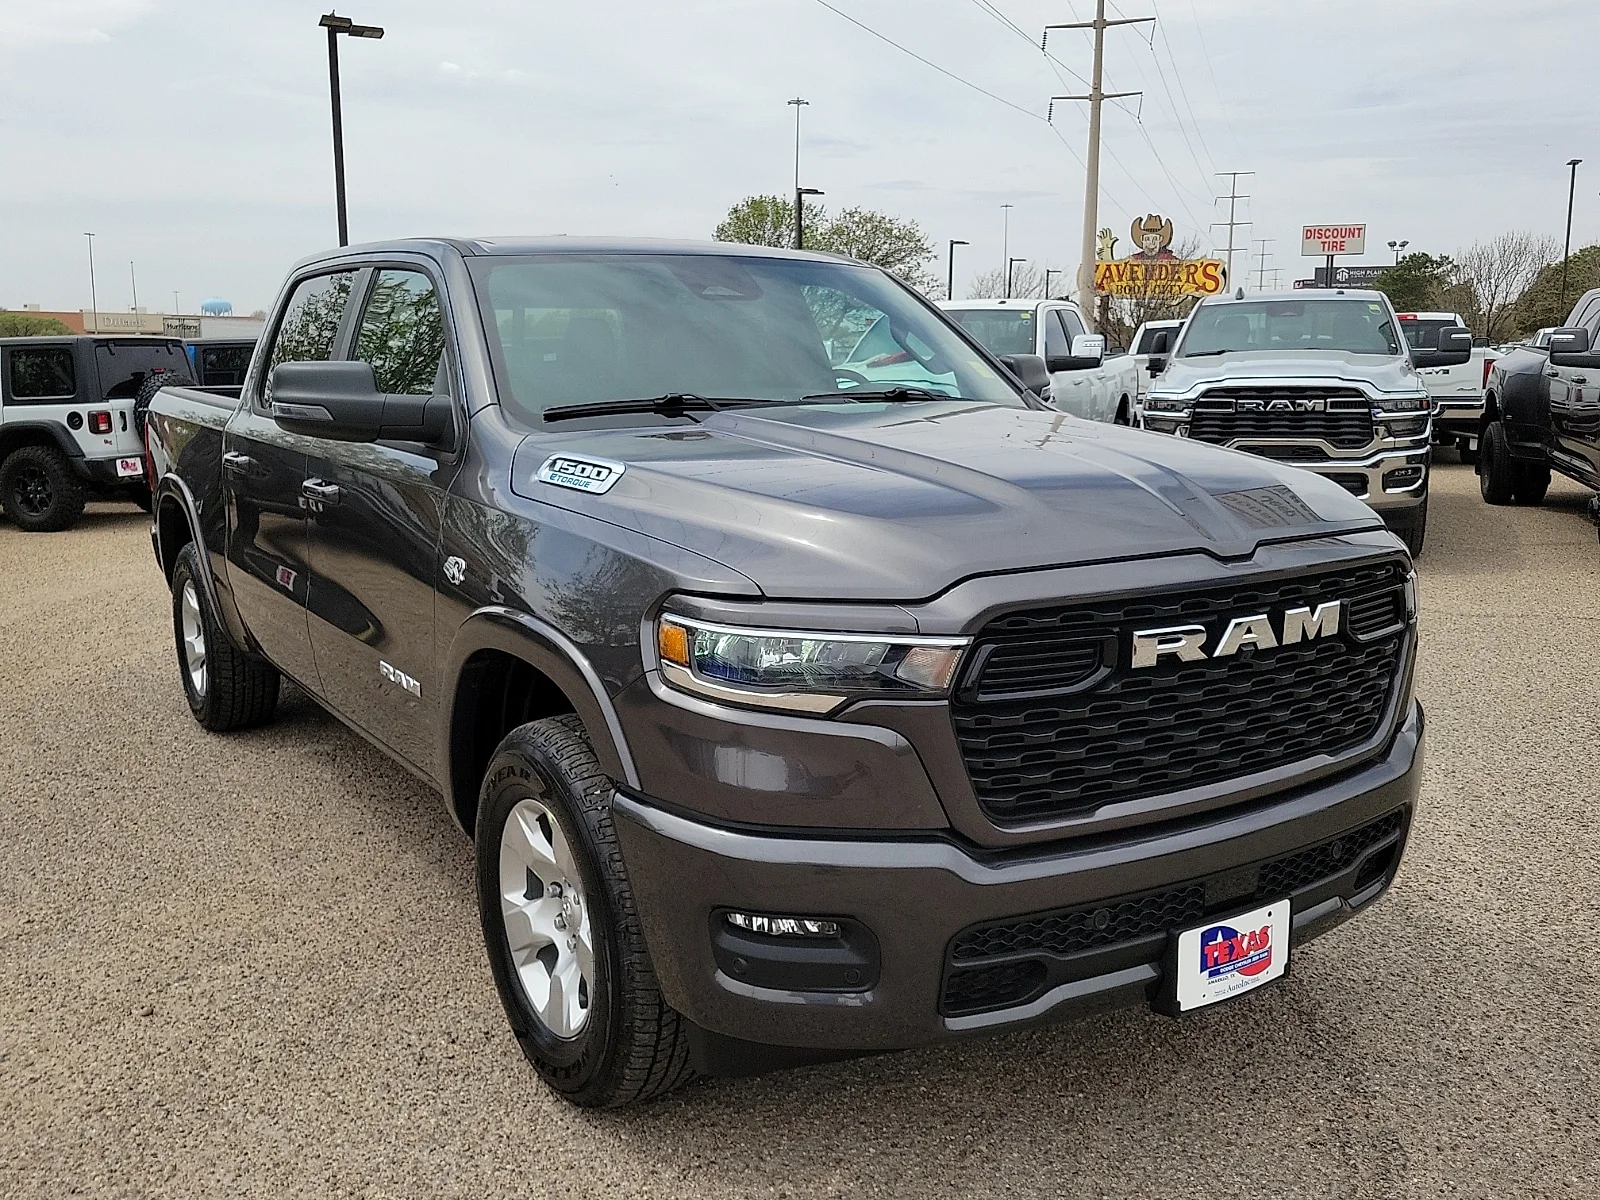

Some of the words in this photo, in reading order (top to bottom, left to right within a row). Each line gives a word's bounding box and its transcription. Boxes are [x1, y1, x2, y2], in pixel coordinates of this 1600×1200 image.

[1305, 227, 1363, 240] DISCOUNT
[1321, 240, 1346, 252] TIRE
[1094, 260, 1221, 294] AVENDER'S
[1237, 399, 1325, 411] RAM
[553, 459, 611, 481] 1500
[1131, 600, 1341, 669] RAM
[379, 660, 421, 697] RAM
[1203, 925, 1270, 968] TEXAS
